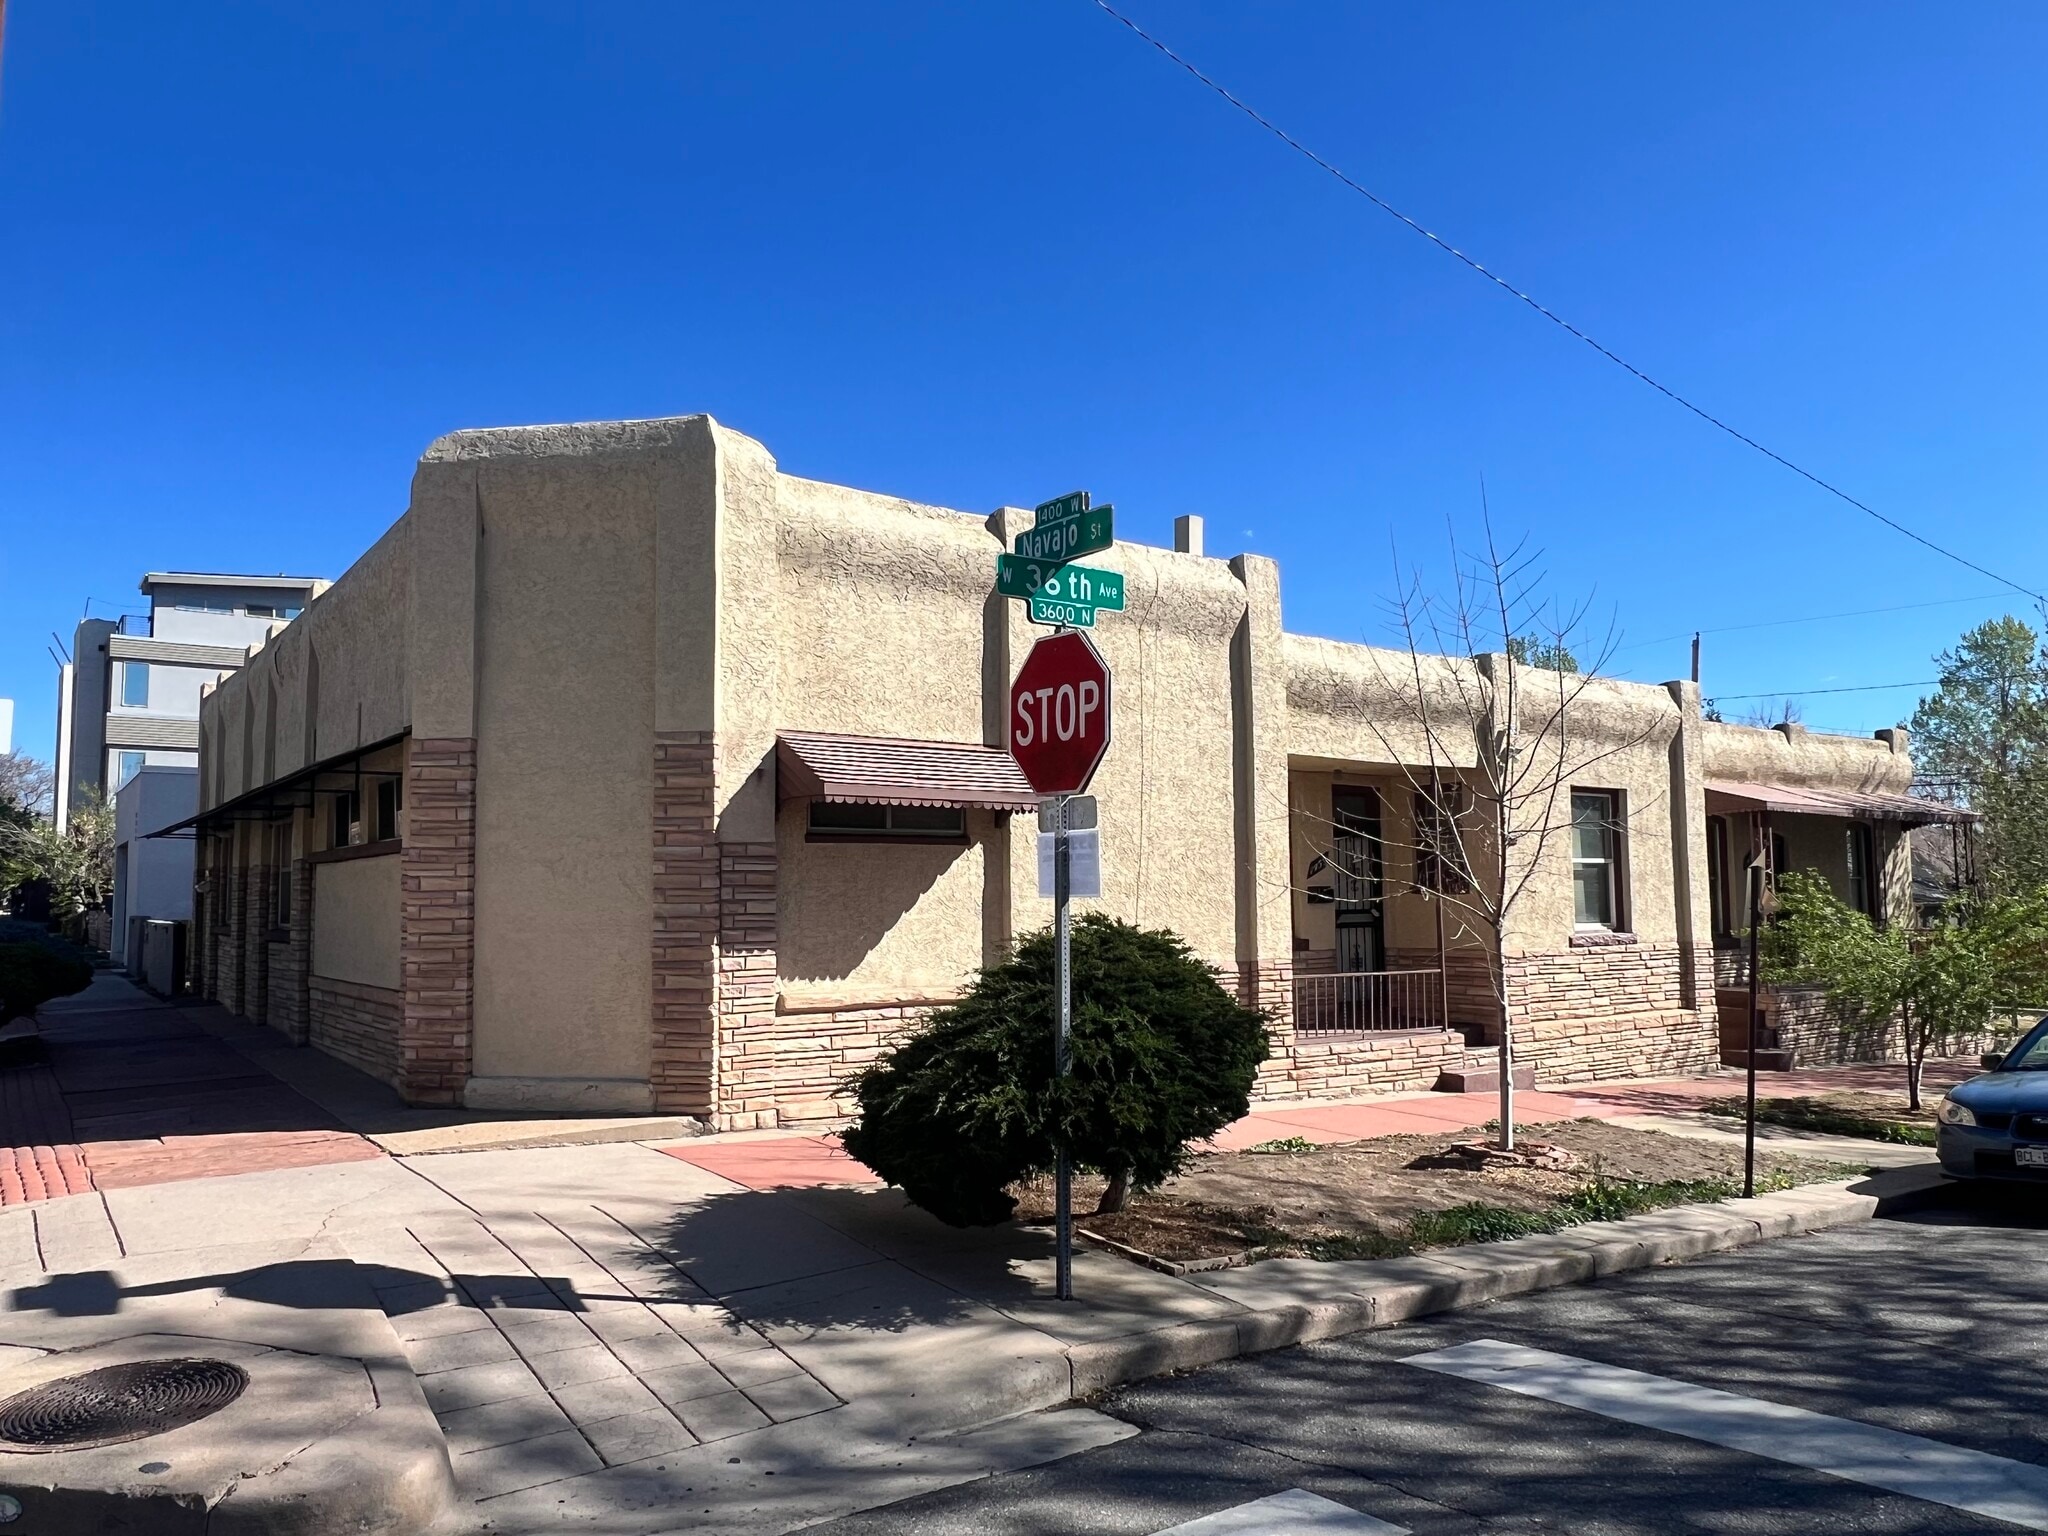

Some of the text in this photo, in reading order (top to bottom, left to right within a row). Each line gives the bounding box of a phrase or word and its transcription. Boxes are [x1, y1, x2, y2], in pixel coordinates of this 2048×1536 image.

[1038, 496, 1079, 522] 1400 W
[1023, 520, 1101, 557] Navajo St
[1002, 564, 1117, 601] W 36th Ave
[1039, 603, 1090, 624] 3600 N
[1015, 680, 1099, 746] STOP
